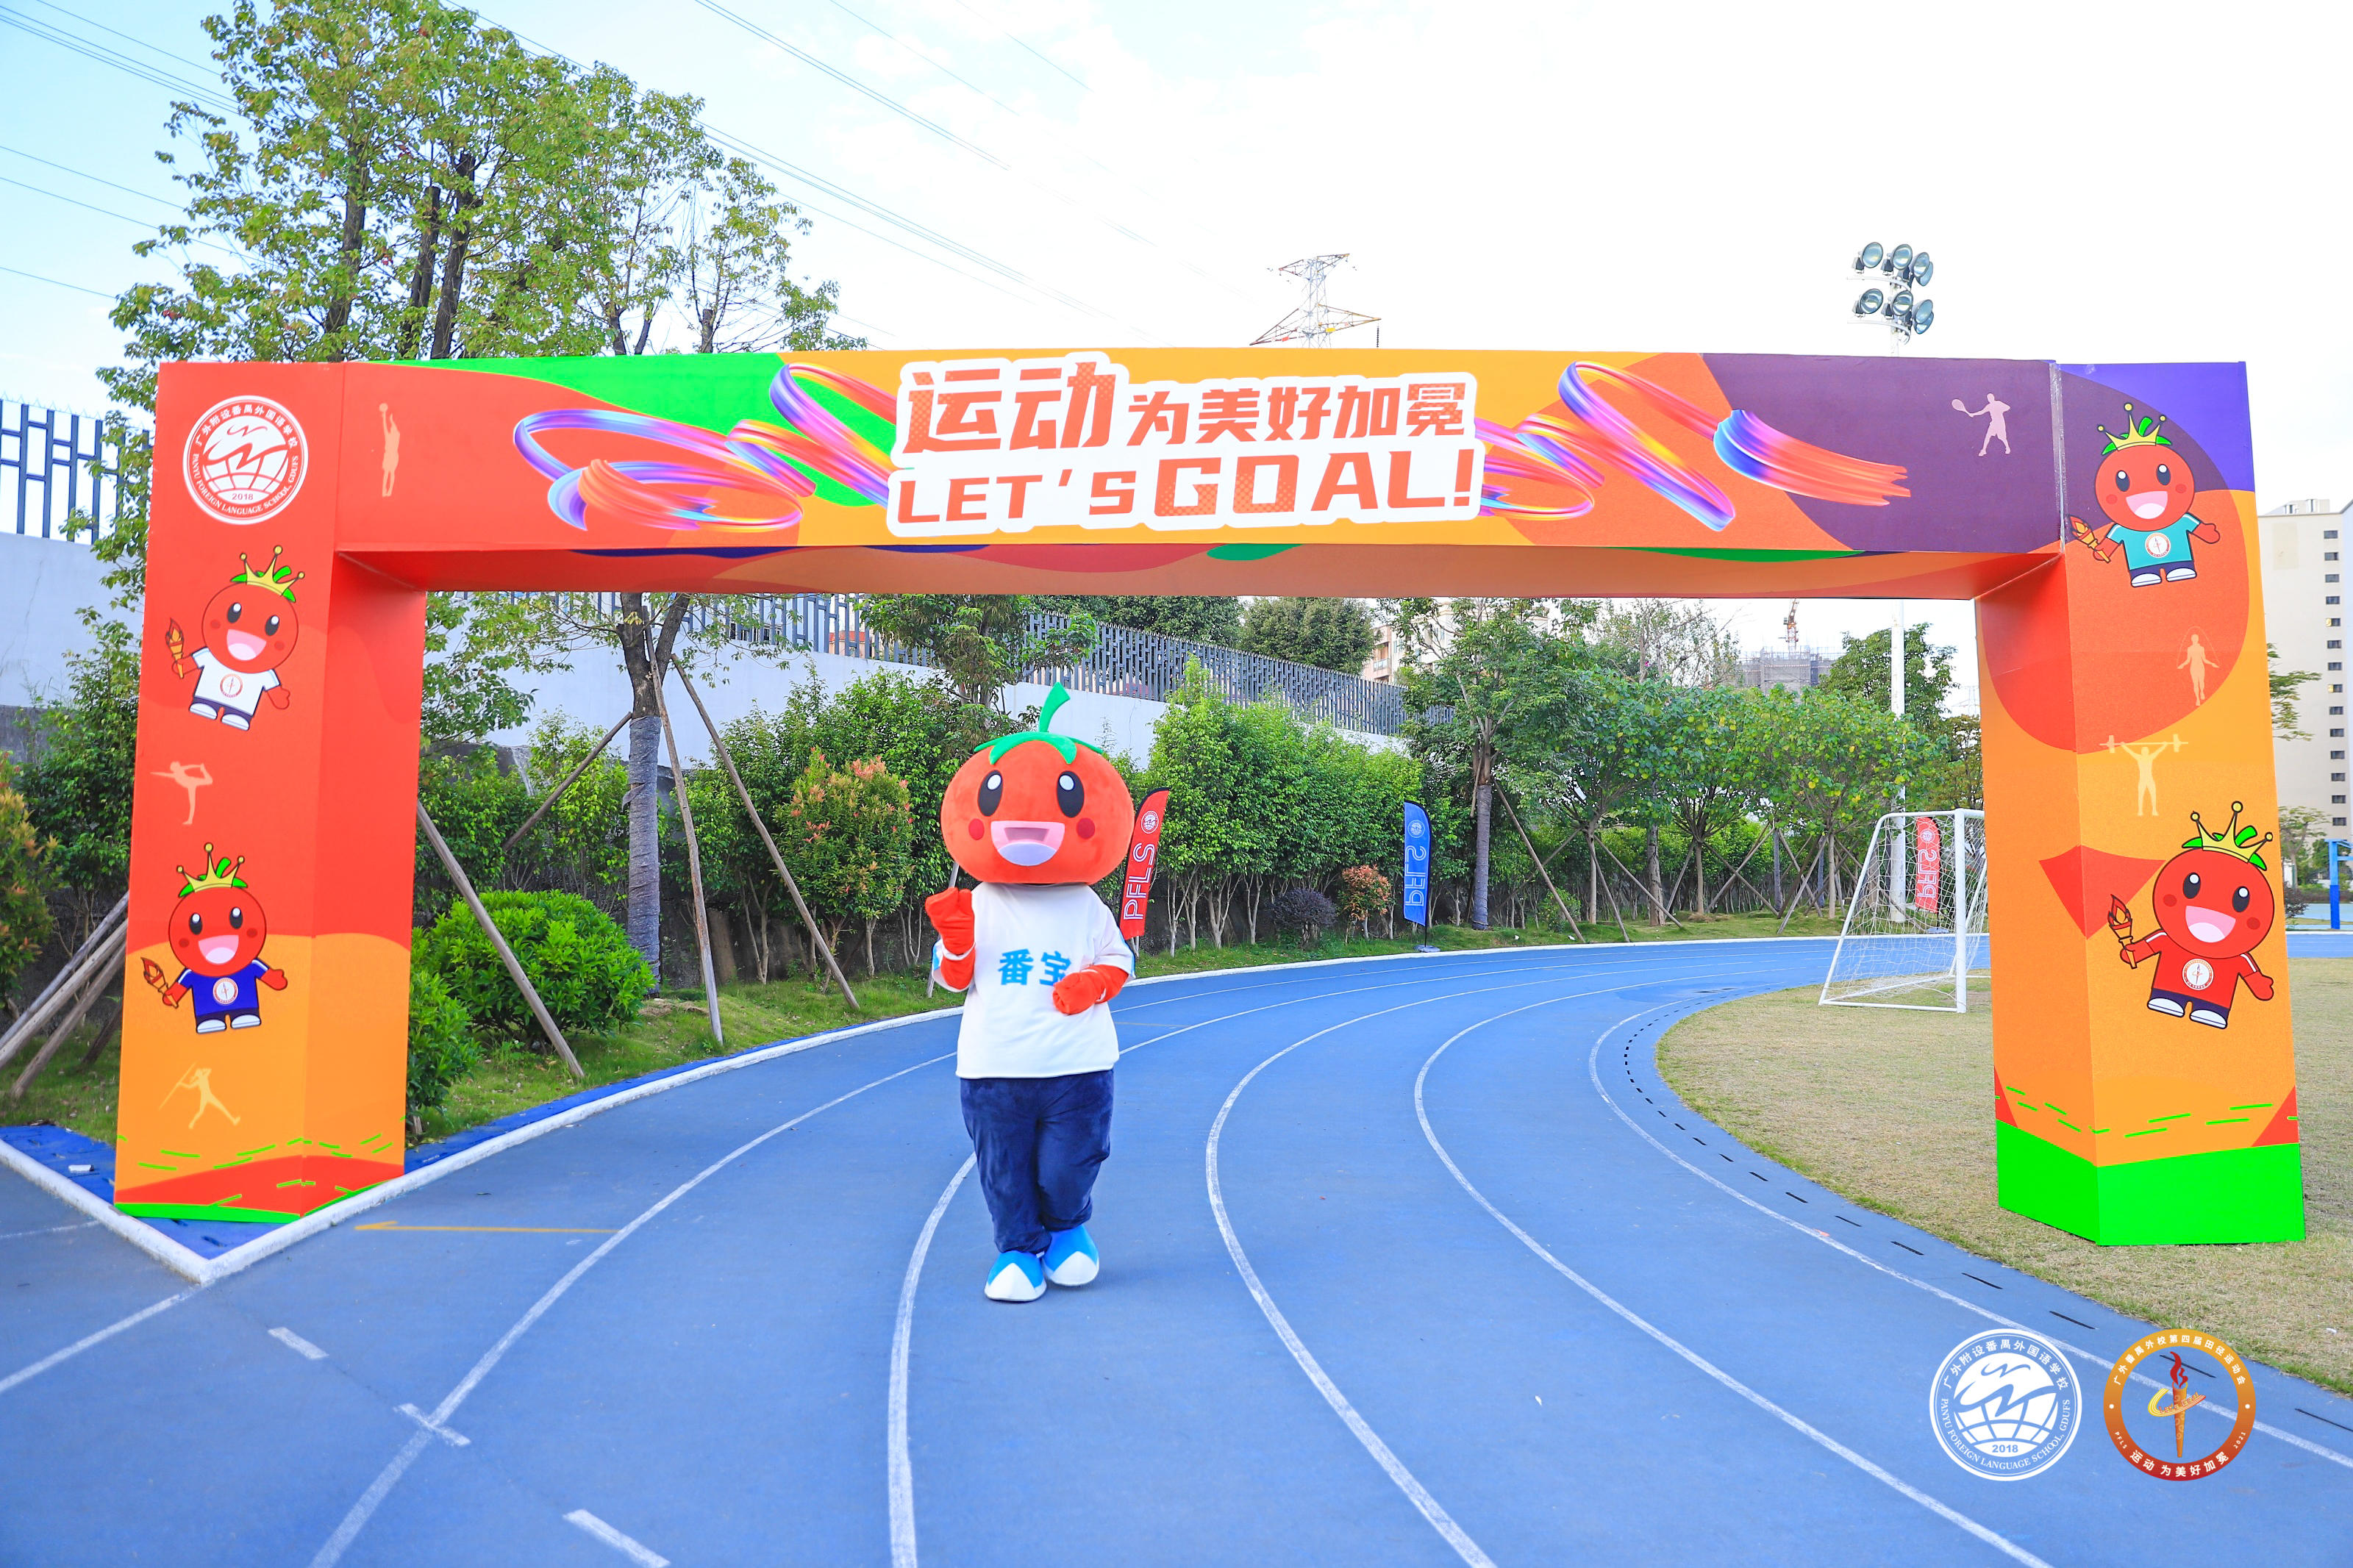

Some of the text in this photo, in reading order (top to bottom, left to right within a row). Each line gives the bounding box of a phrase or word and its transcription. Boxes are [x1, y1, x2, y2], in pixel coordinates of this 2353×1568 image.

[903, 361, 1467, 454] 运动为美好加冕
[192, 453, 201, 479] PANYU
[288, 455, 299, 483] GDUFS
[196, 478, 221, 508] FOREIGN
[232, 493, 254, 501] 2018
[897, 448, 1475, 523] LET'S GOAL!
[222, 504, 263, 515] LANGUAGE
[1123, 842, 1155, 920] PFLS
[998, 948, 1071, 987] 番宝
